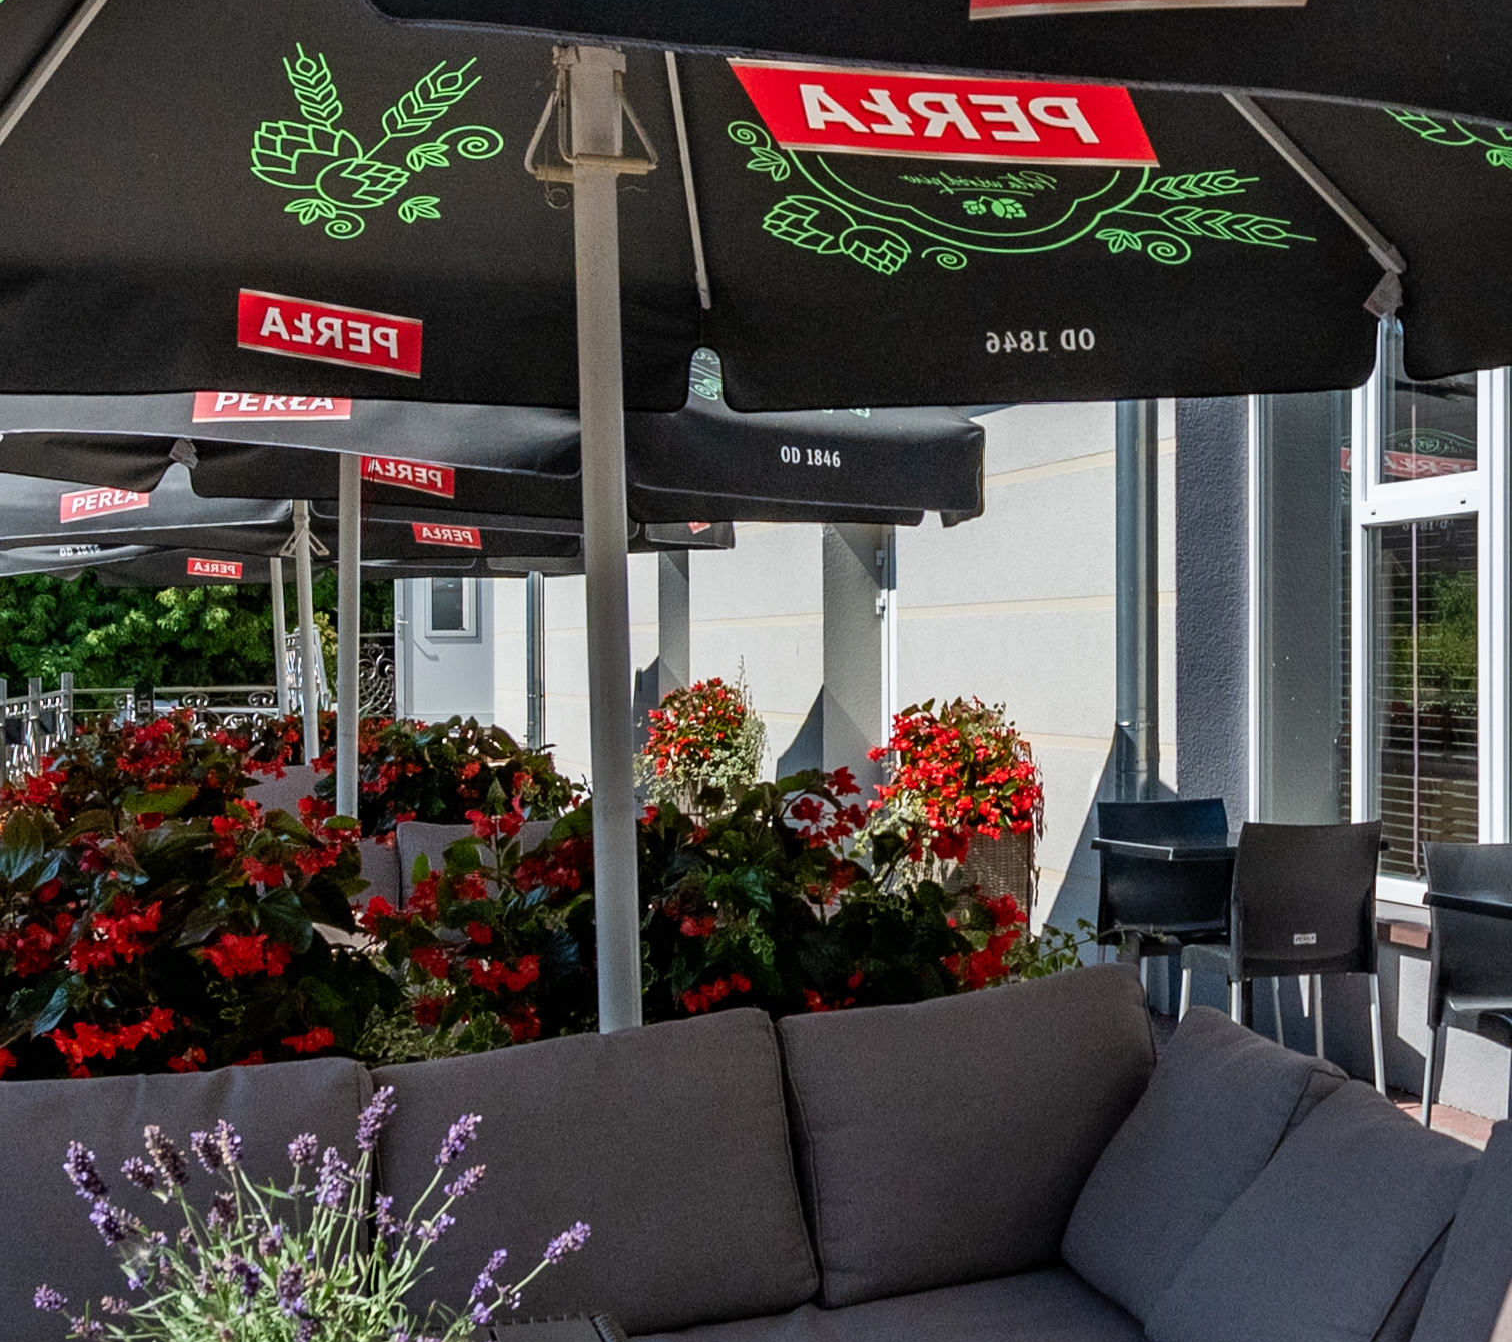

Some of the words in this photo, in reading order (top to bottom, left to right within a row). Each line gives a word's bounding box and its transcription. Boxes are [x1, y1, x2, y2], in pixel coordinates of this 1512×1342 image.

[214, 391, 335, 413] PERŁA
[780, 445, 801, 464] OD
[806, 448, 841, 468] 1846
[71, 489, 140, 514] PERŁA
